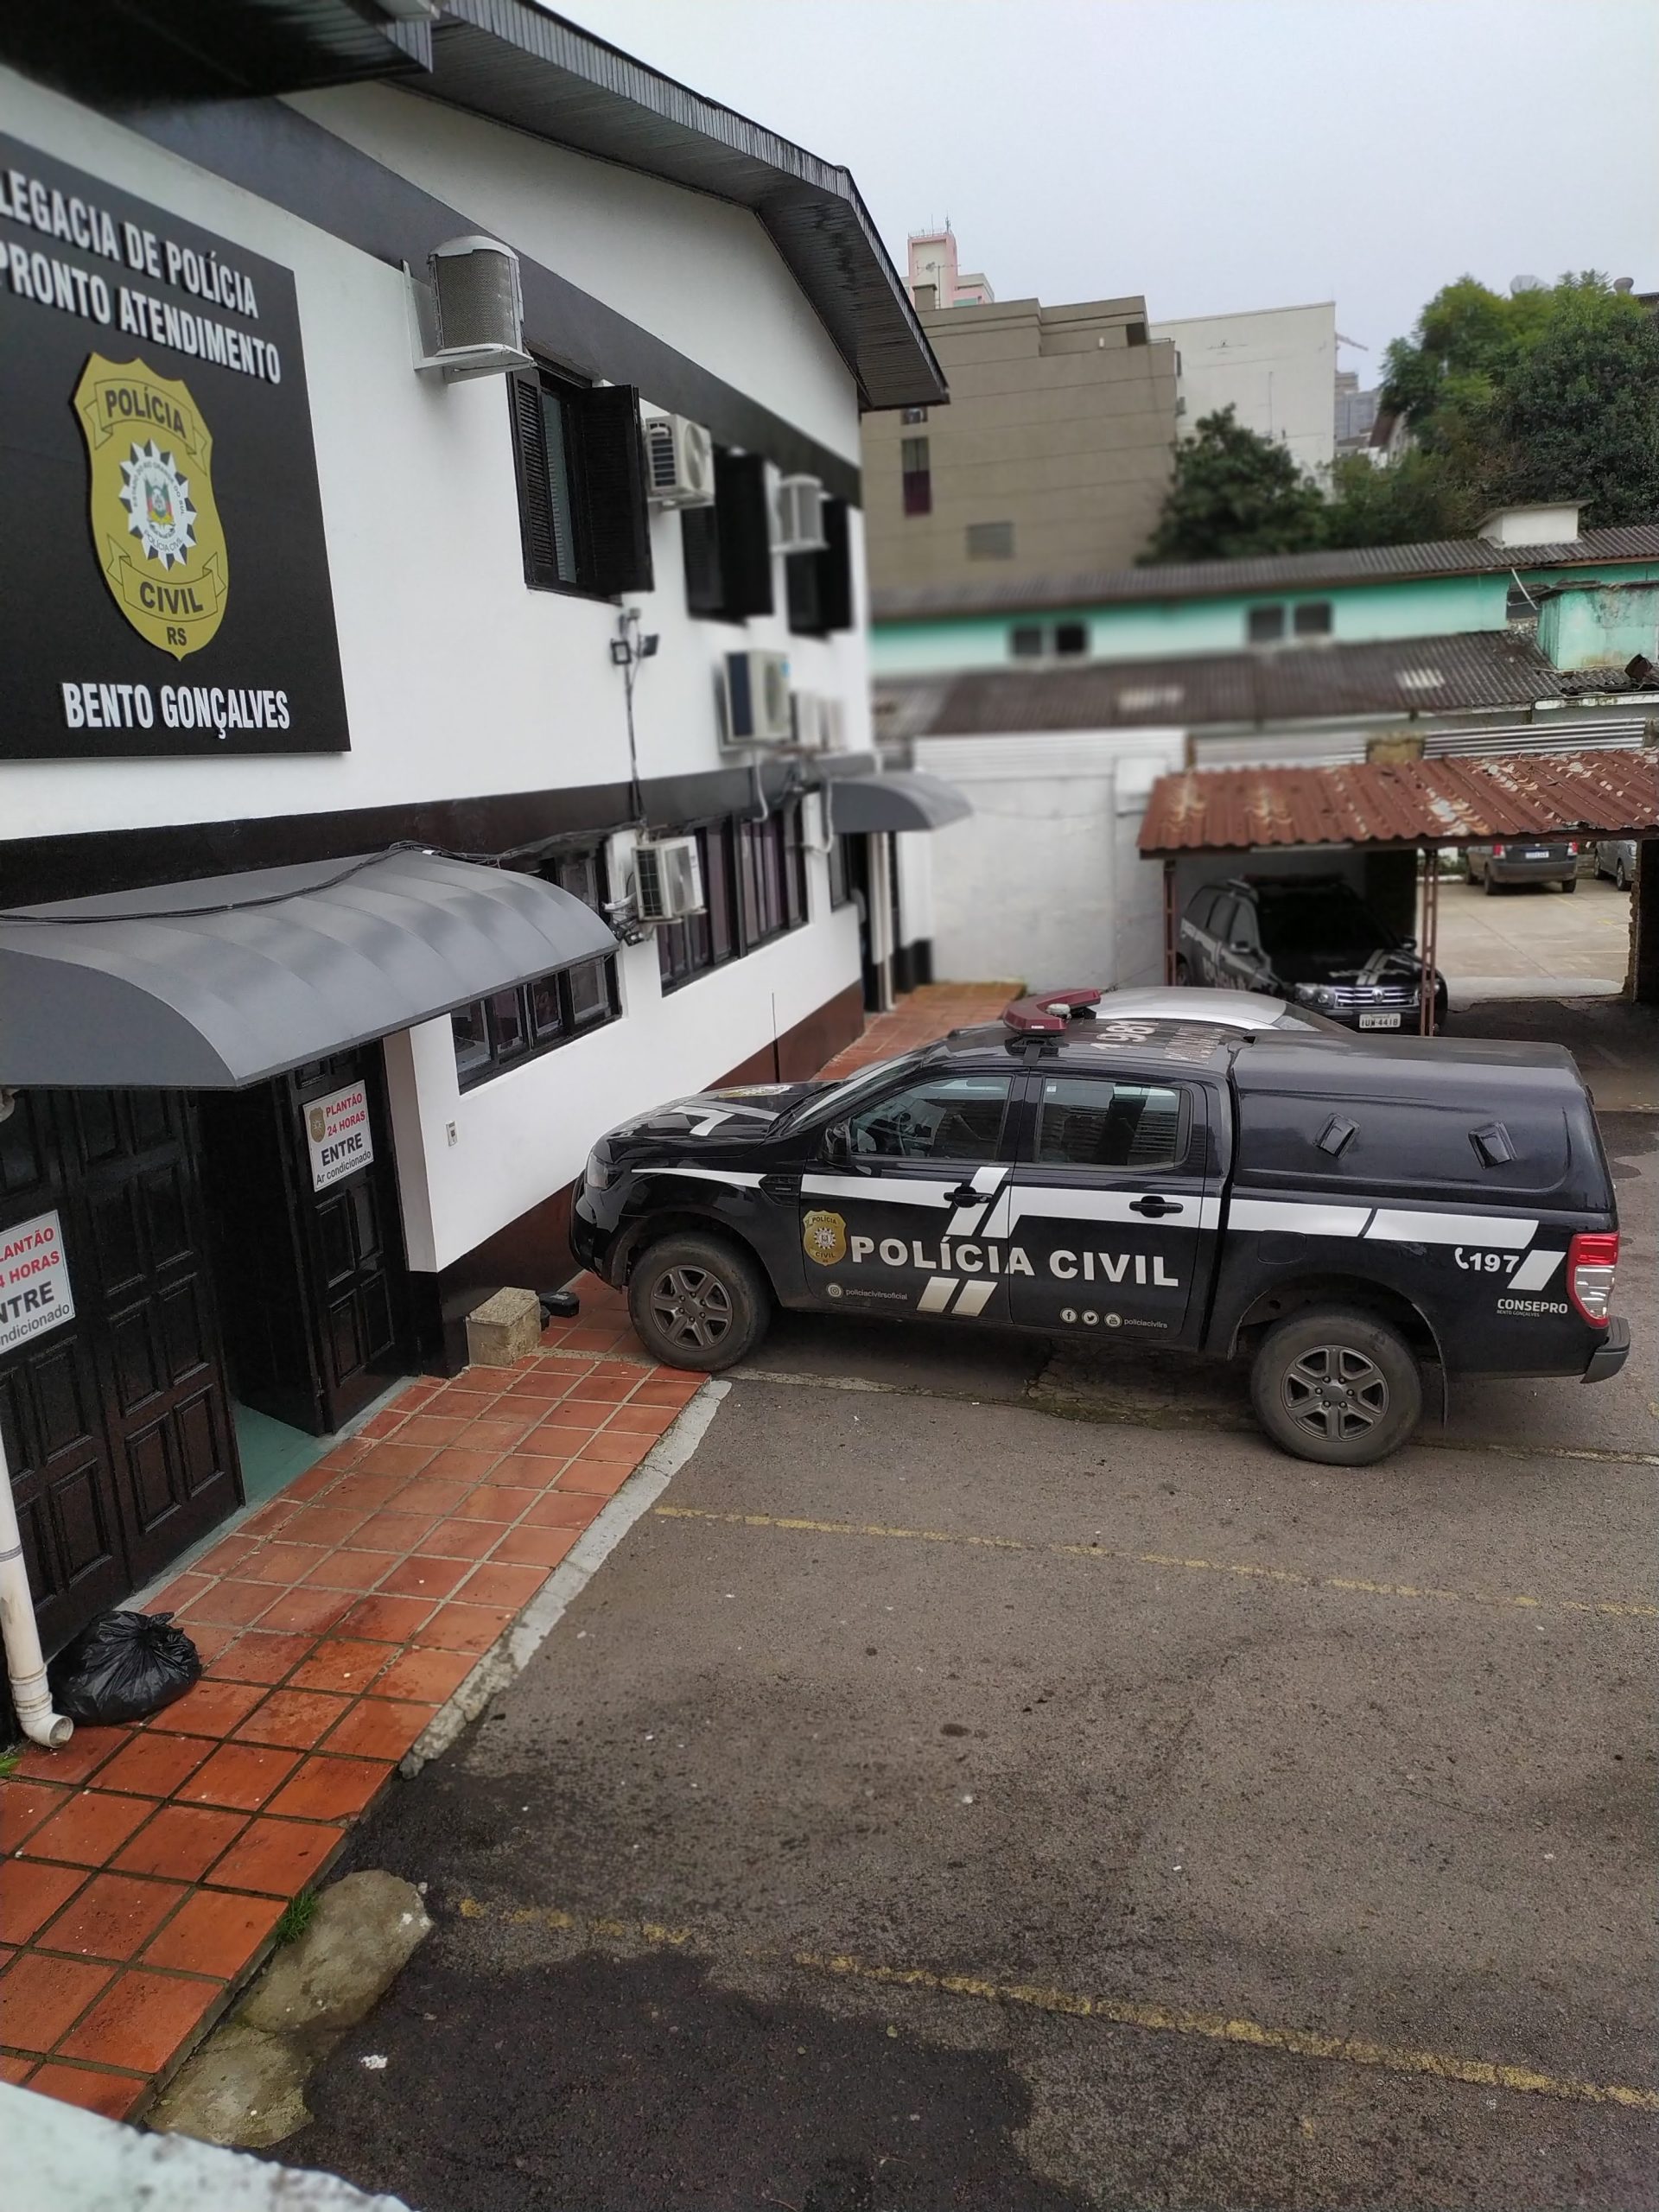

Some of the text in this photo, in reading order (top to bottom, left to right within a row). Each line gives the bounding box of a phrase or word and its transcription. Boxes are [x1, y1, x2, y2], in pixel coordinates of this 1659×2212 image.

[124, 221, 161, 278] DE
[166, 240, 259, 319] POLÍCIA
[120, 286, 282, 385] ATENDIMENTO
[105, 386, 188, 440] POLÍCIA
[140, 581, 204, 615] CIVIL
[167, 626, 188, 647] RS
[61, 682, 290, 740] BENTO GONÇALVES
[325, 1092, 363, 1117] PLANTÃO
[327, 1110, 366, 1137] 24 HORAS
[321, 1132, 363, 1166] ENTRE
[316, 1150, 372, 1185] Ar condicionado
[812, 1216, 837, 1225] POLÍCIA
[9, 1250, 60, 1285] HORAS
[850, 1236, 1179, 1287] POLÍCIA CIVIL
[1469, 1252, 1520, 1274] 197
[1497, 1298, 1568, 1314] CONSEPRO
